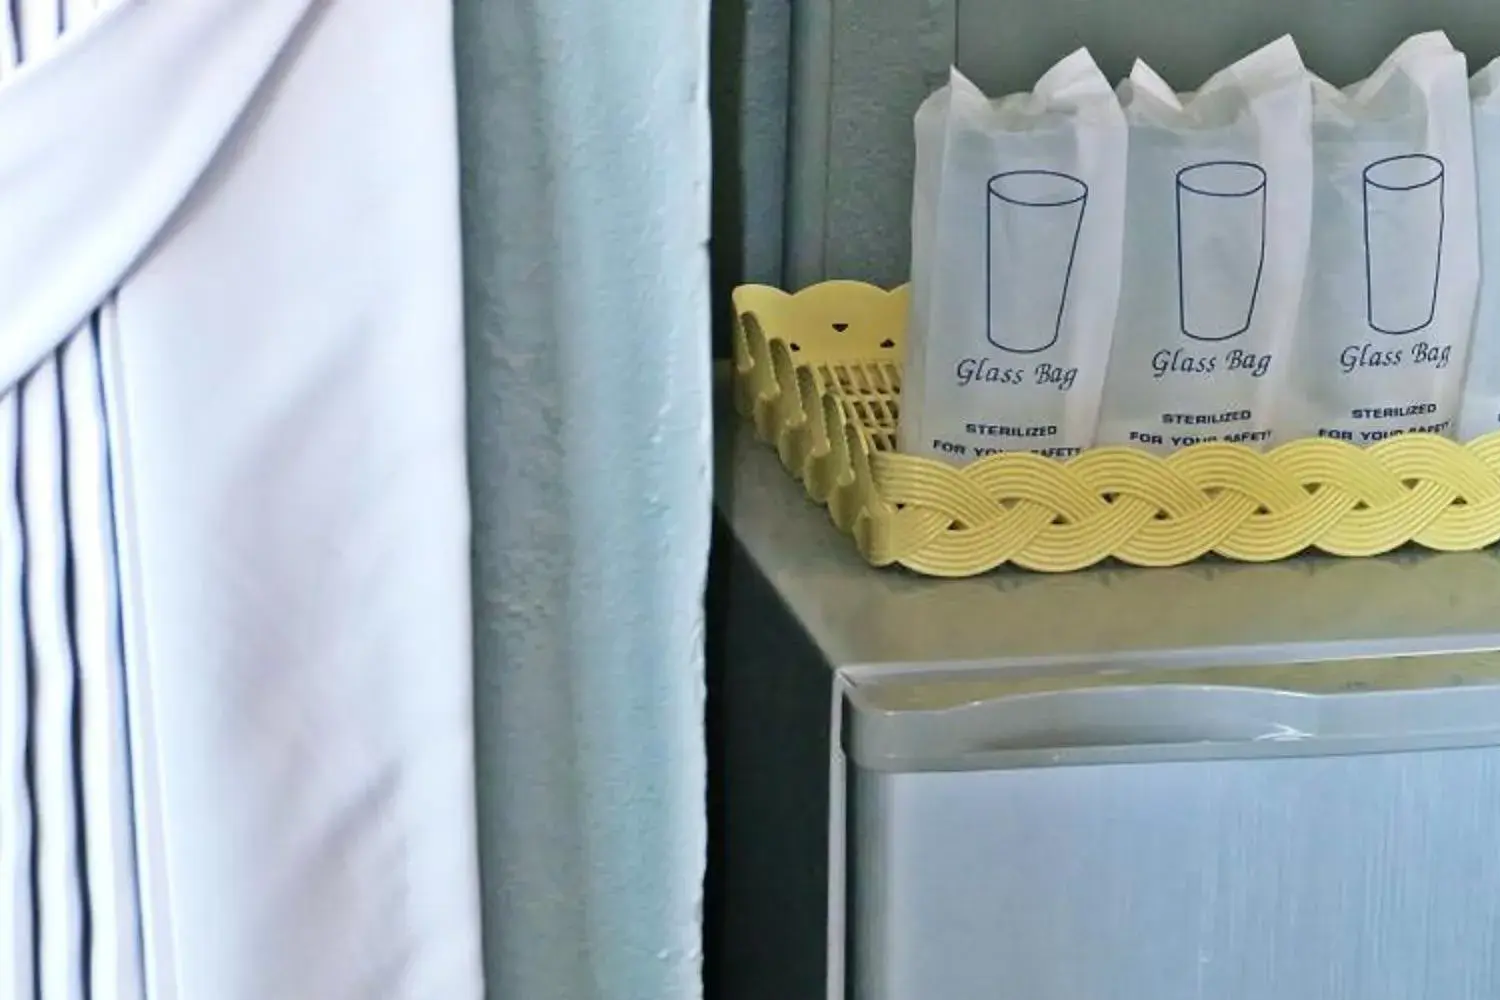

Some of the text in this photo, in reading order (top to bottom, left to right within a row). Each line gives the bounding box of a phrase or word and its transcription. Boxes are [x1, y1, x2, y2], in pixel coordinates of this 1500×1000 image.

[1151, 348, 1272, 378] Glass Bag
[1339, 341, 1452, 373] Glass Bag
[956, 358, 1078, 390] Glass Bag
[1161, 409, 1252, 425] STERILIZED
[1351, 402, 1437, 419] STERILIZED
[965, 422, 1058, 438] STERILIZED
[1129, 431, 1163, 445] FOR
[1317, 428, 1353, 441] FOR
[932, 439, 966, 455] FOR
